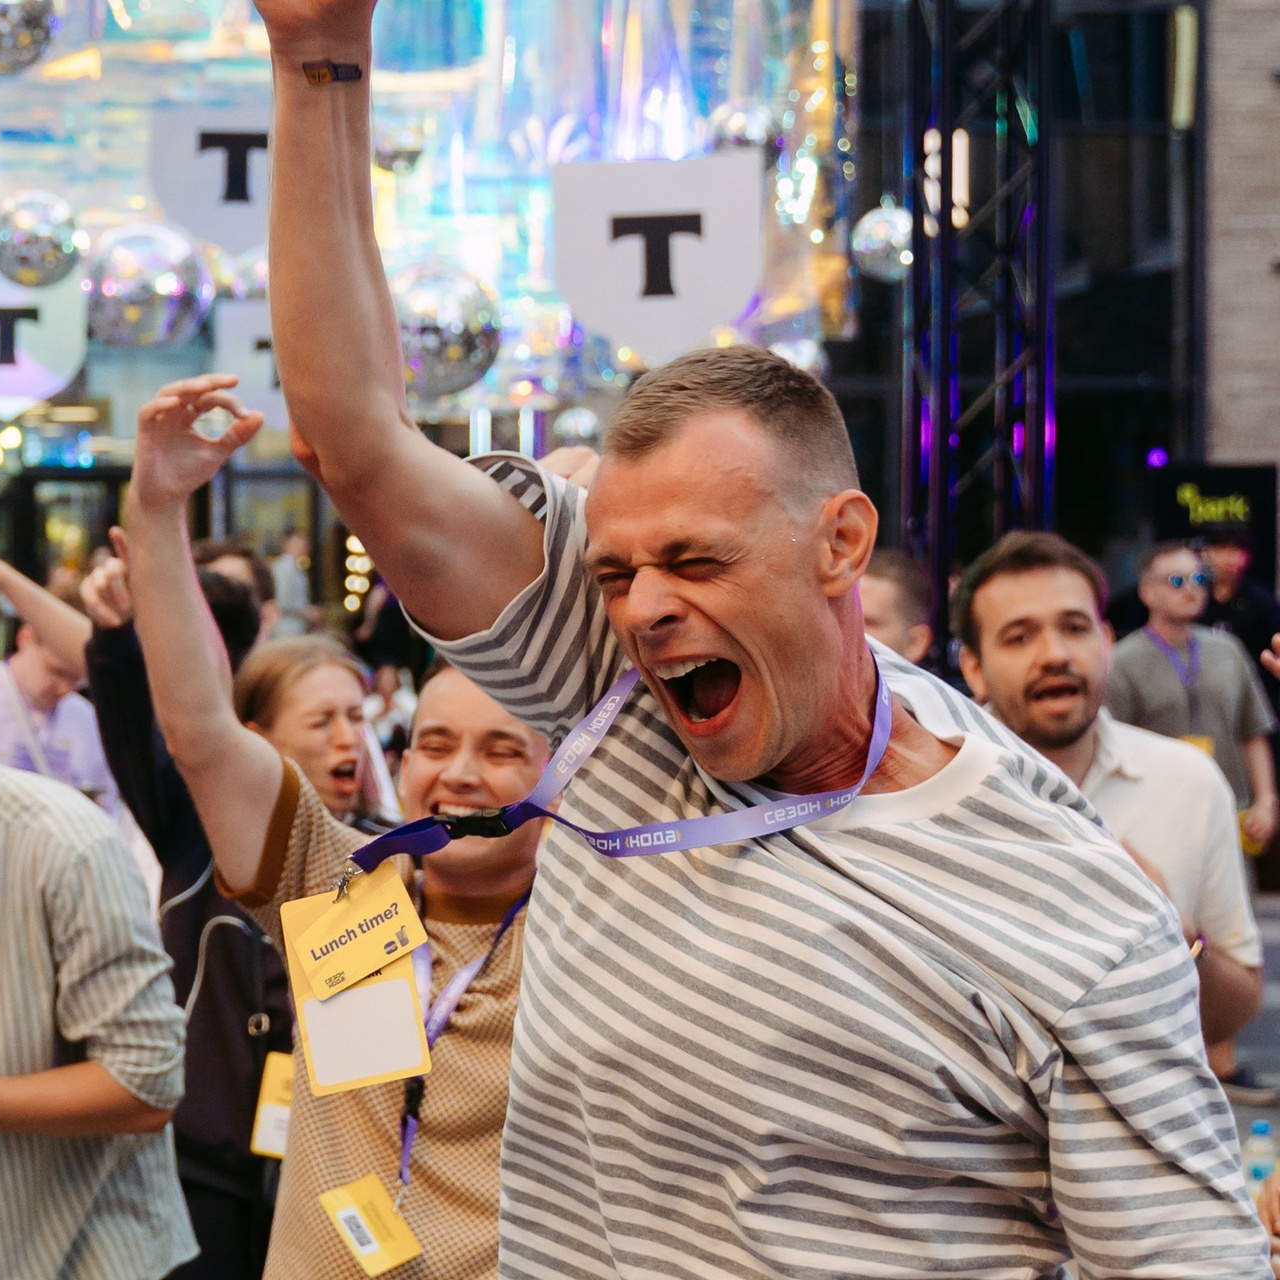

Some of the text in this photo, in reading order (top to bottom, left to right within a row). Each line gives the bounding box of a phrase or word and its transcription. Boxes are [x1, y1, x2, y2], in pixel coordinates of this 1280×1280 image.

[610, 213, 703, 297] T
[309, 901, 400, 962] Lunch time?
